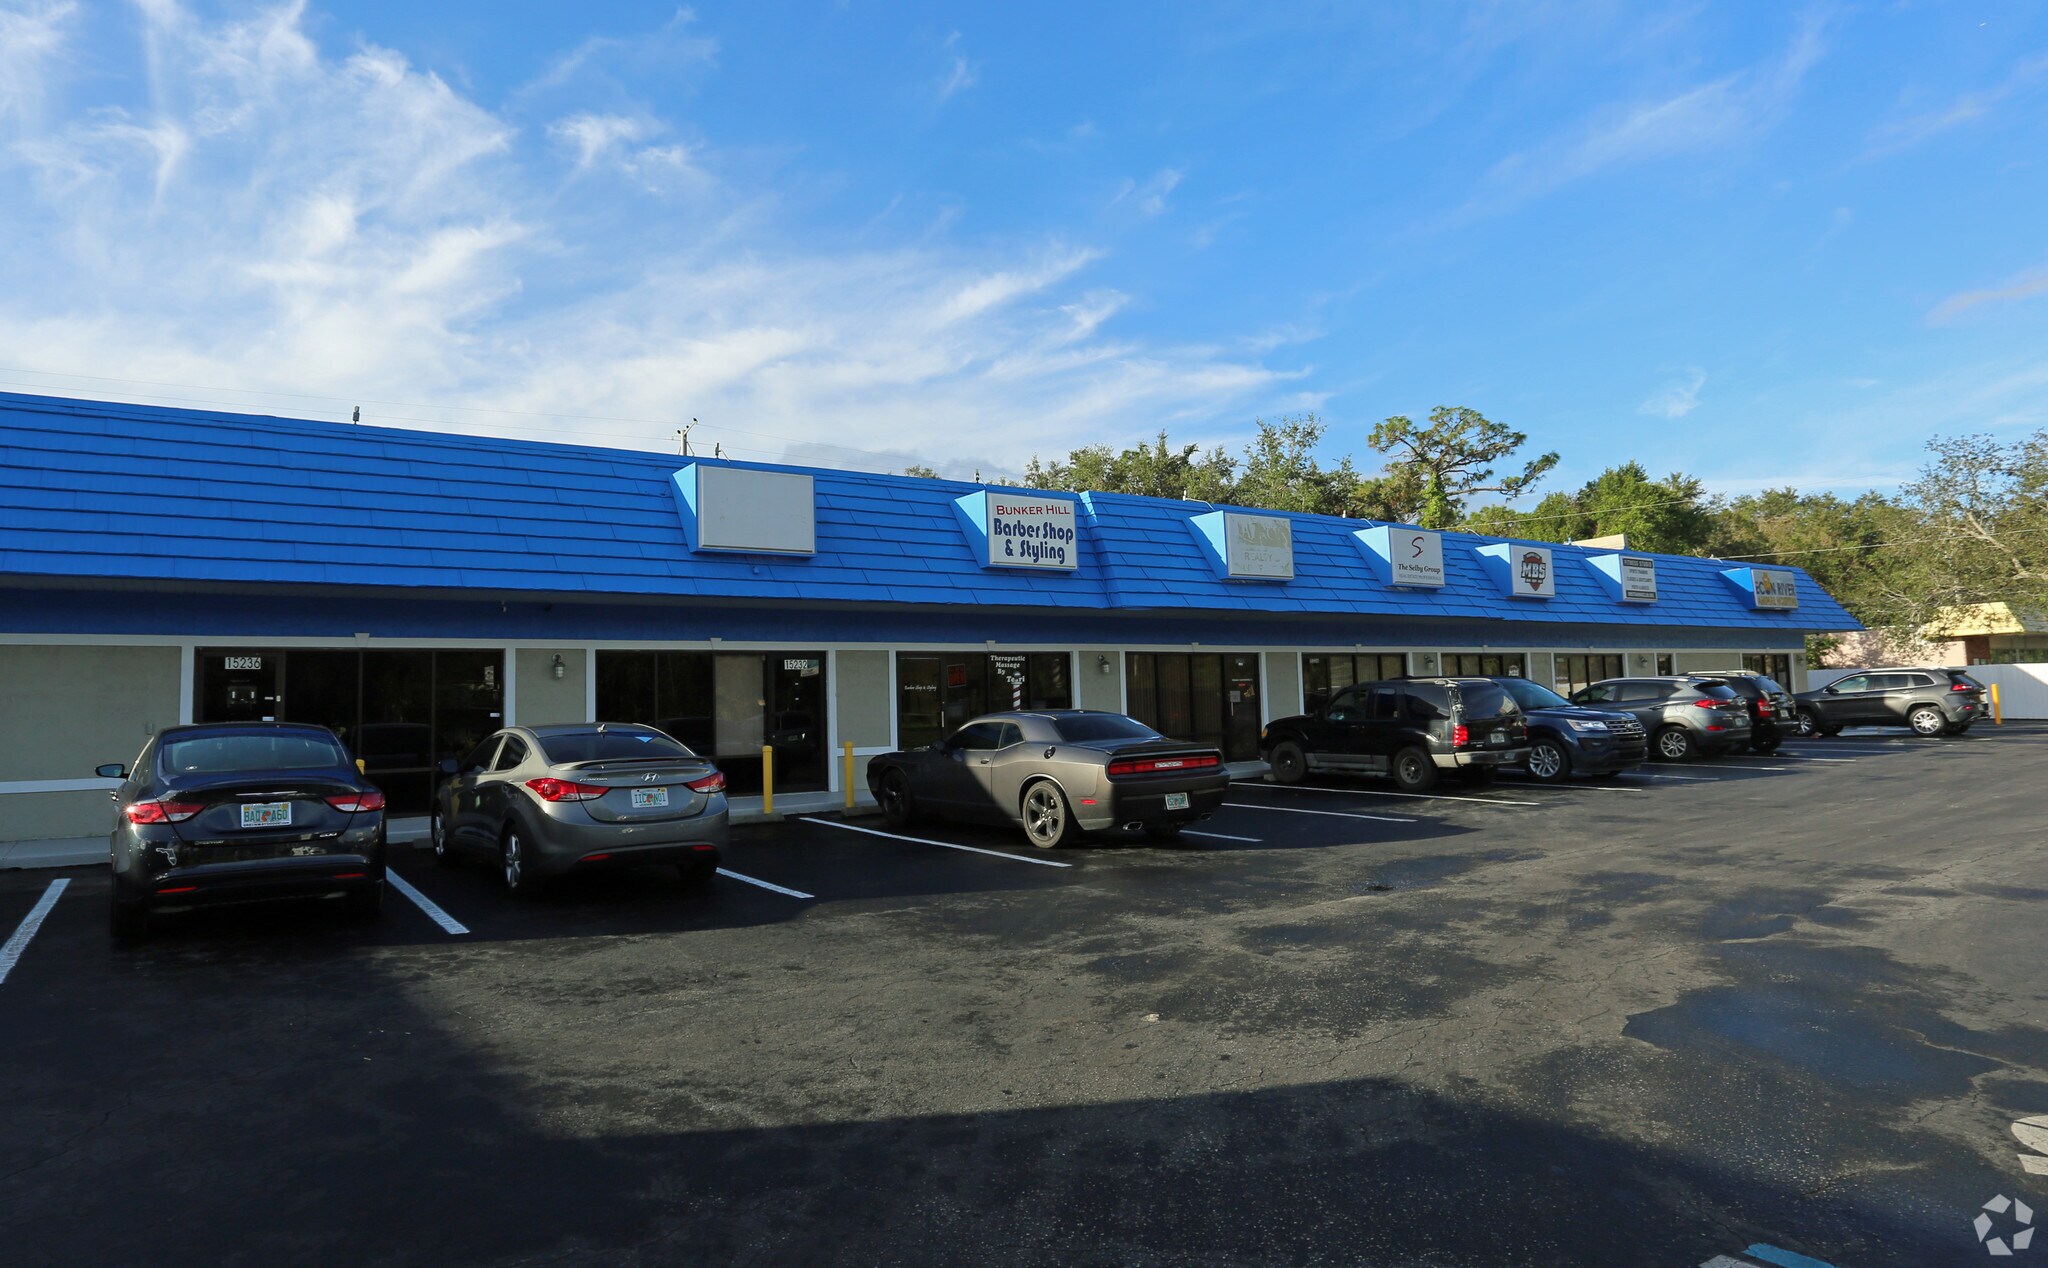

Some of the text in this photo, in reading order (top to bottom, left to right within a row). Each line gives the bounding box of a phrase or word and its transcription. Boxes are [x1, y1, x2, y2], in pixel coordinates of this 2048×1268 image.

[996, 505, 1070, 515] BUNKER HILL
[994, 518, 1074, 544] Barber Shop
[1005, 539, 1064, 564] & Styling
[1408, 564, 1423, 573] Selby
[1424, 566, 1440, 574] Group
[1522, 562, 1546, 579] MBS
[1777, 582, 1796, 596] RIVER
[227, 657, 260, 669] 15236
[785, 660, 808, 670] 15232
